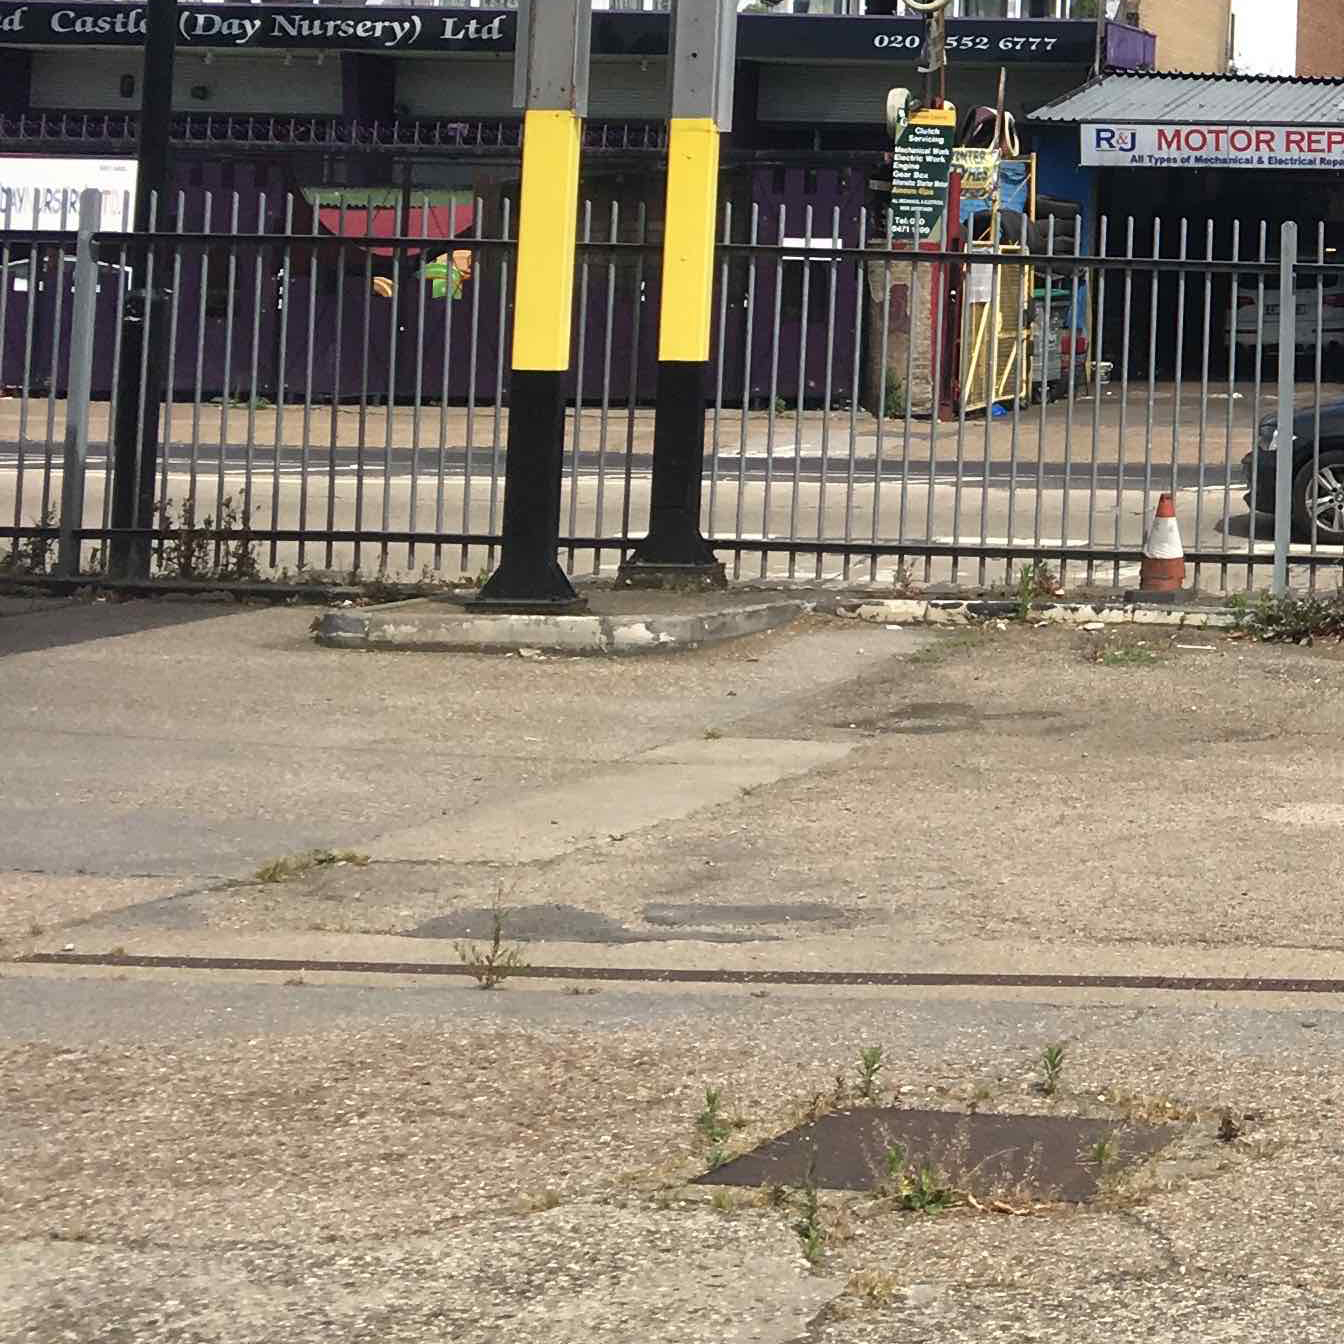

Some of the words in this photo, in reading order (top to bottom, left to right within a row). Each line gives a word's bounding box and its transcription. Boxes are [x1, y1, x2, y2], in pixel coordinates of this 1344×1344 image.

[179, 10, 262, 44] (Day
[269, 14, 422, 47] Nursery)
[440, 15, 507, 40] Ltd
[874, 34, 920, 49] 020
[943, 35, 990, 50] 552
[998, 36, 1058, 51] 6777
[1095, 127, 1137, 153] R&J
[1156, 128, 1276, 153] MOTOR
[1130, 154, 1144, 164] All
[1149, 155, 1178, 166] Types
[1180, 155, 1191, 165] of
[1194, 156, 1254, 166] Mechanical
[1267, 157, 1318, 167] Electrical
[909, 217, 926, 226] 00
